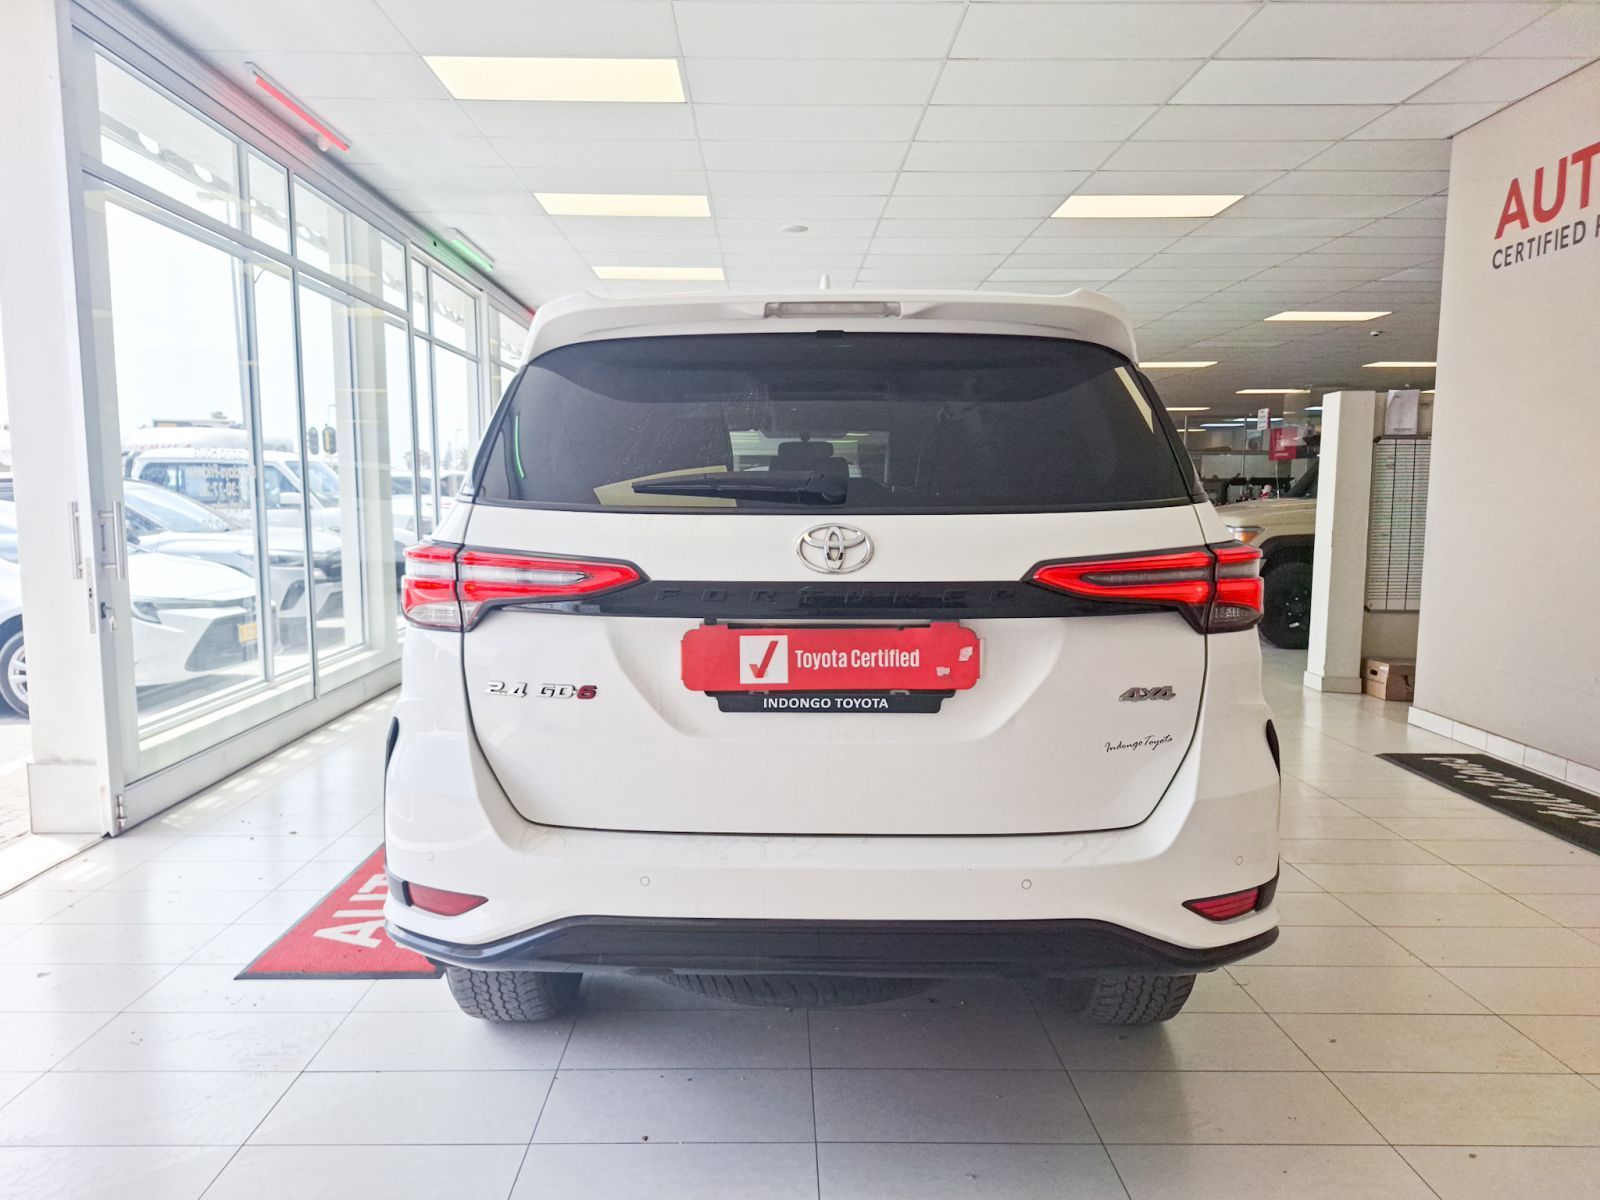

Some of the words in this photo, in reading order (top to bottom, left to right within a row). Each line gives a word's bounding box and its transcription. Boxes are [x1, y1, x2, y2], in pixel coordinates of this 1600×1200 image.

[1492, 220, 1586, 269] CERTIFIED
[795, 650, 848, 670] Toyota
[851, 649, 920, 668] Certified
[484, 680, 528, 698] 2.4
[763, 698, 831, 709] INDONGO
[835, 698, 889, 709] TOYOTA
[1144, 734, 1173, 751] Toyota
